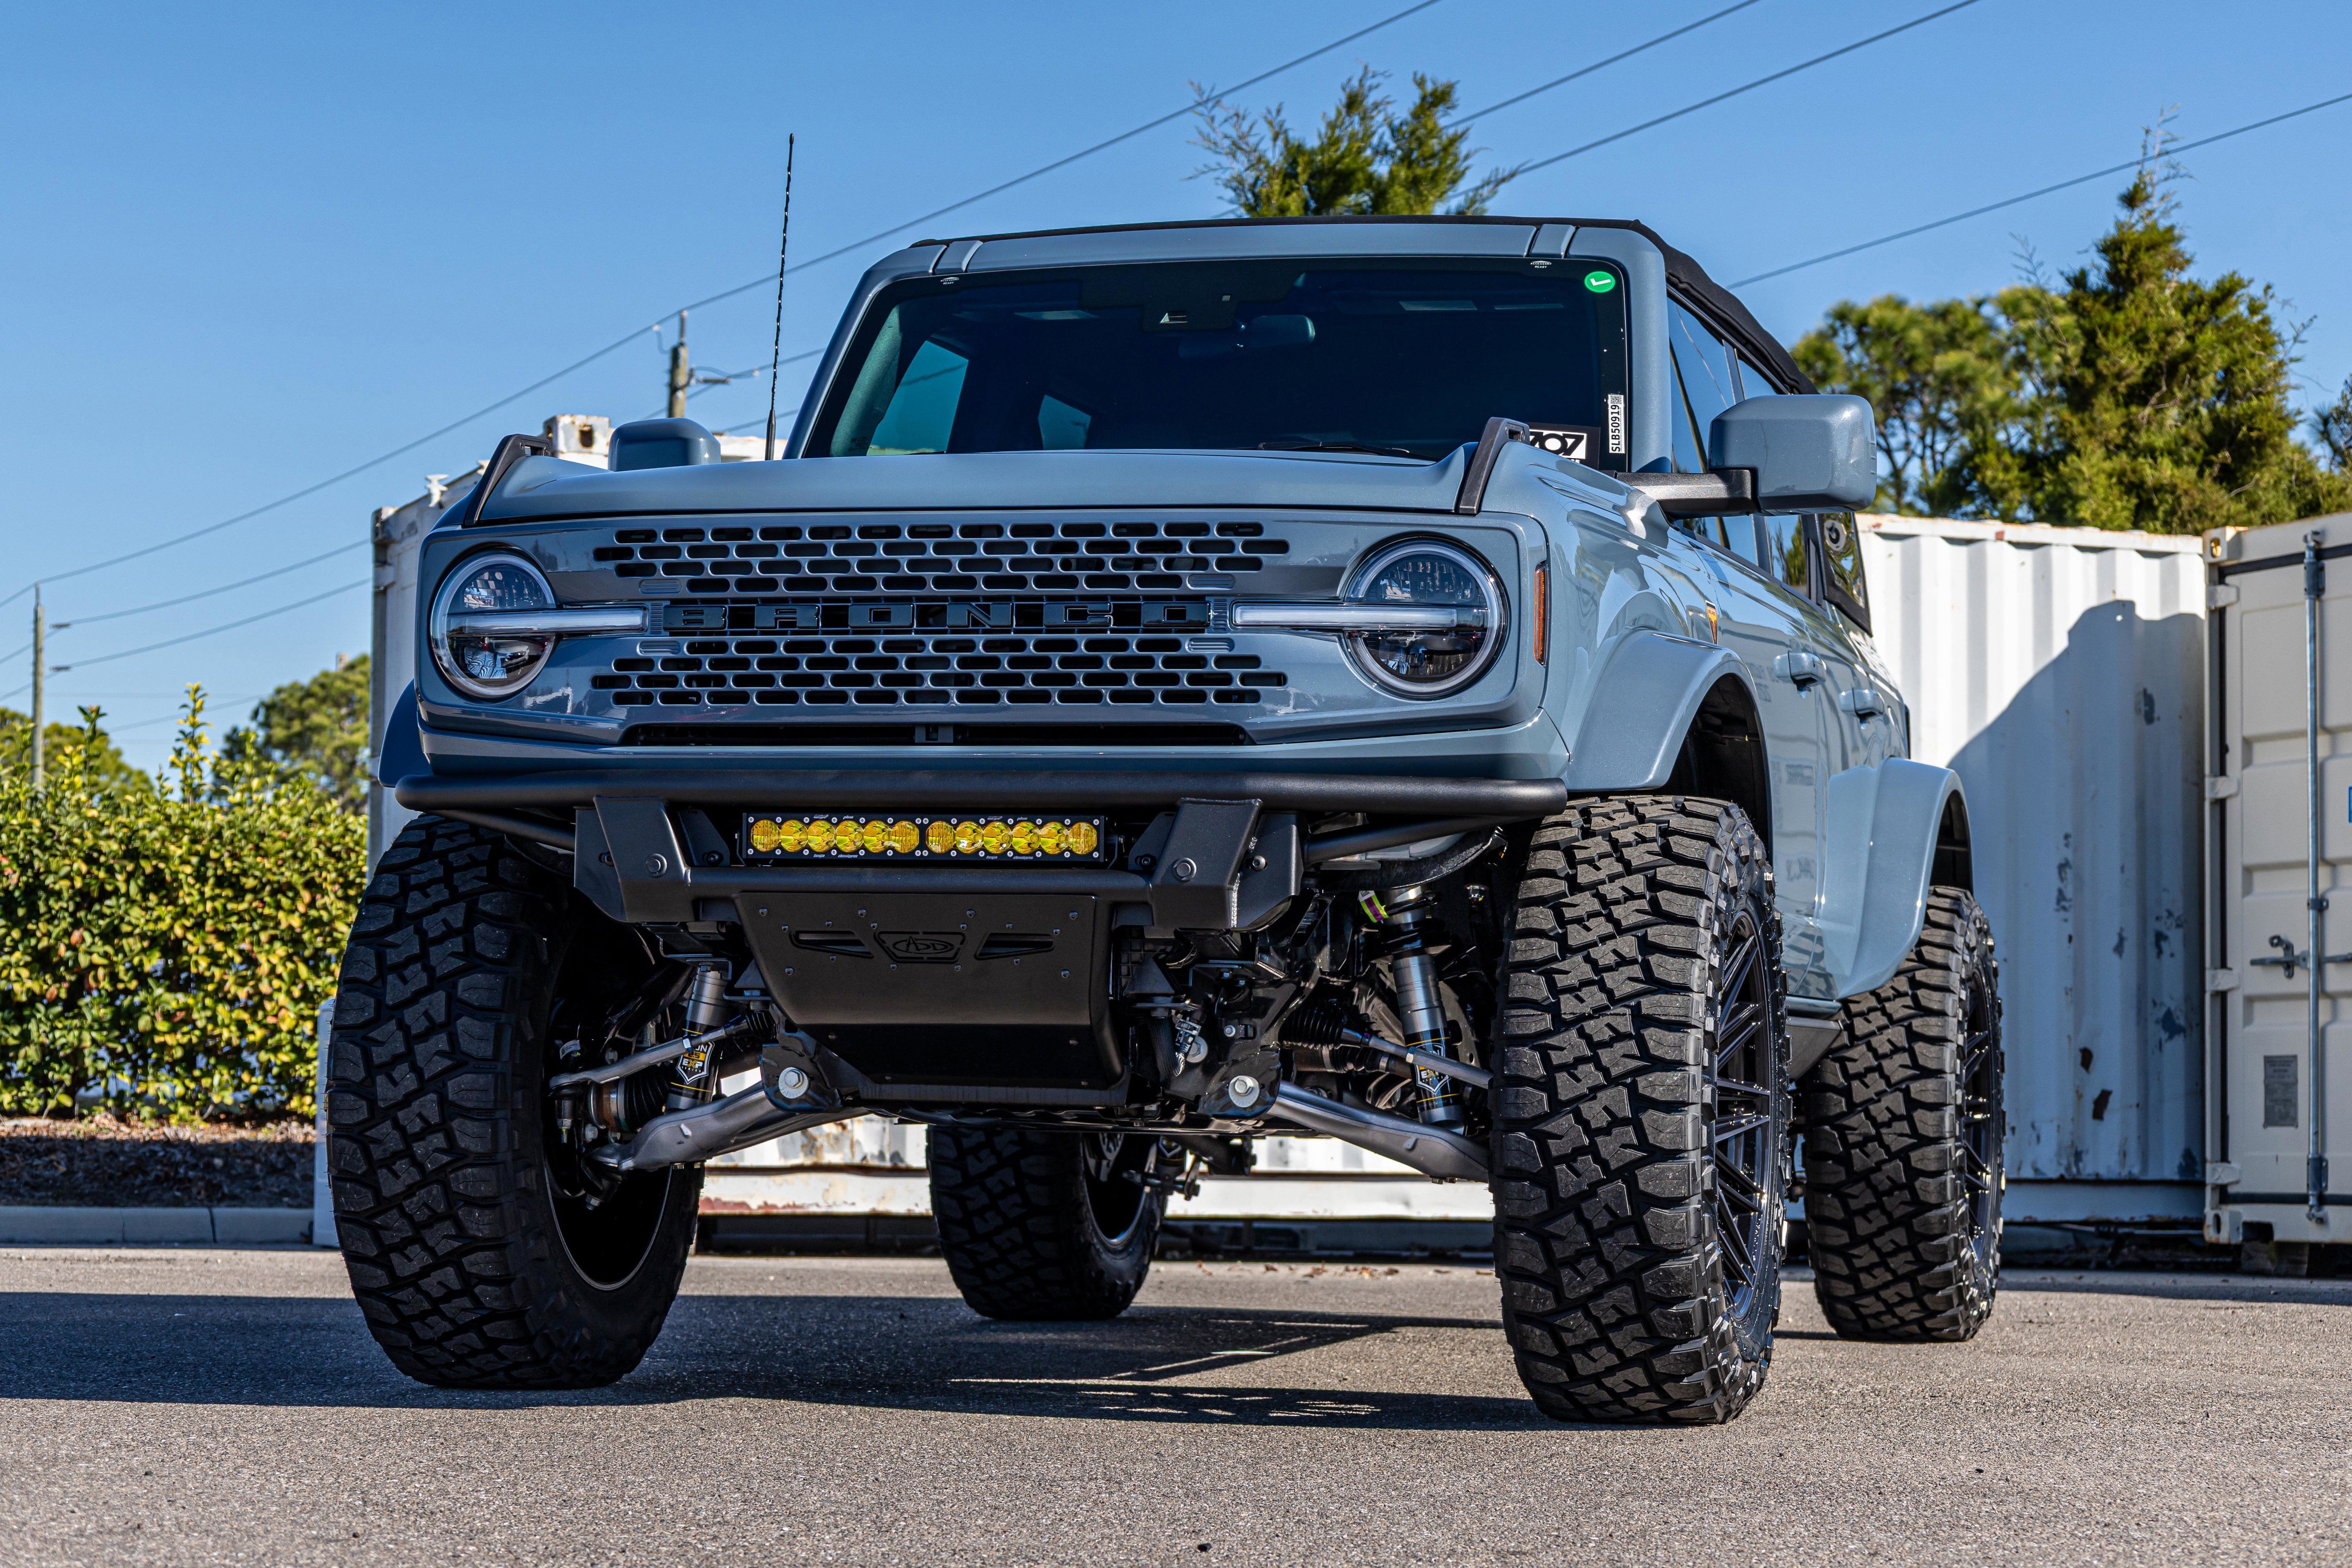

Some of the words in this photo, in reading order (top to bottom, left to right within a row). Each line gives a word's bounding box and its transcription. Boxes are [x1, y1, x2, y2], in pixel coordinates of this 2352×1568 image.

[1610, 404, 1621, 452] SLB50919
[663, 602, 1212, 631] BRONCO
[682, 1058, 703, 1069] EXP
